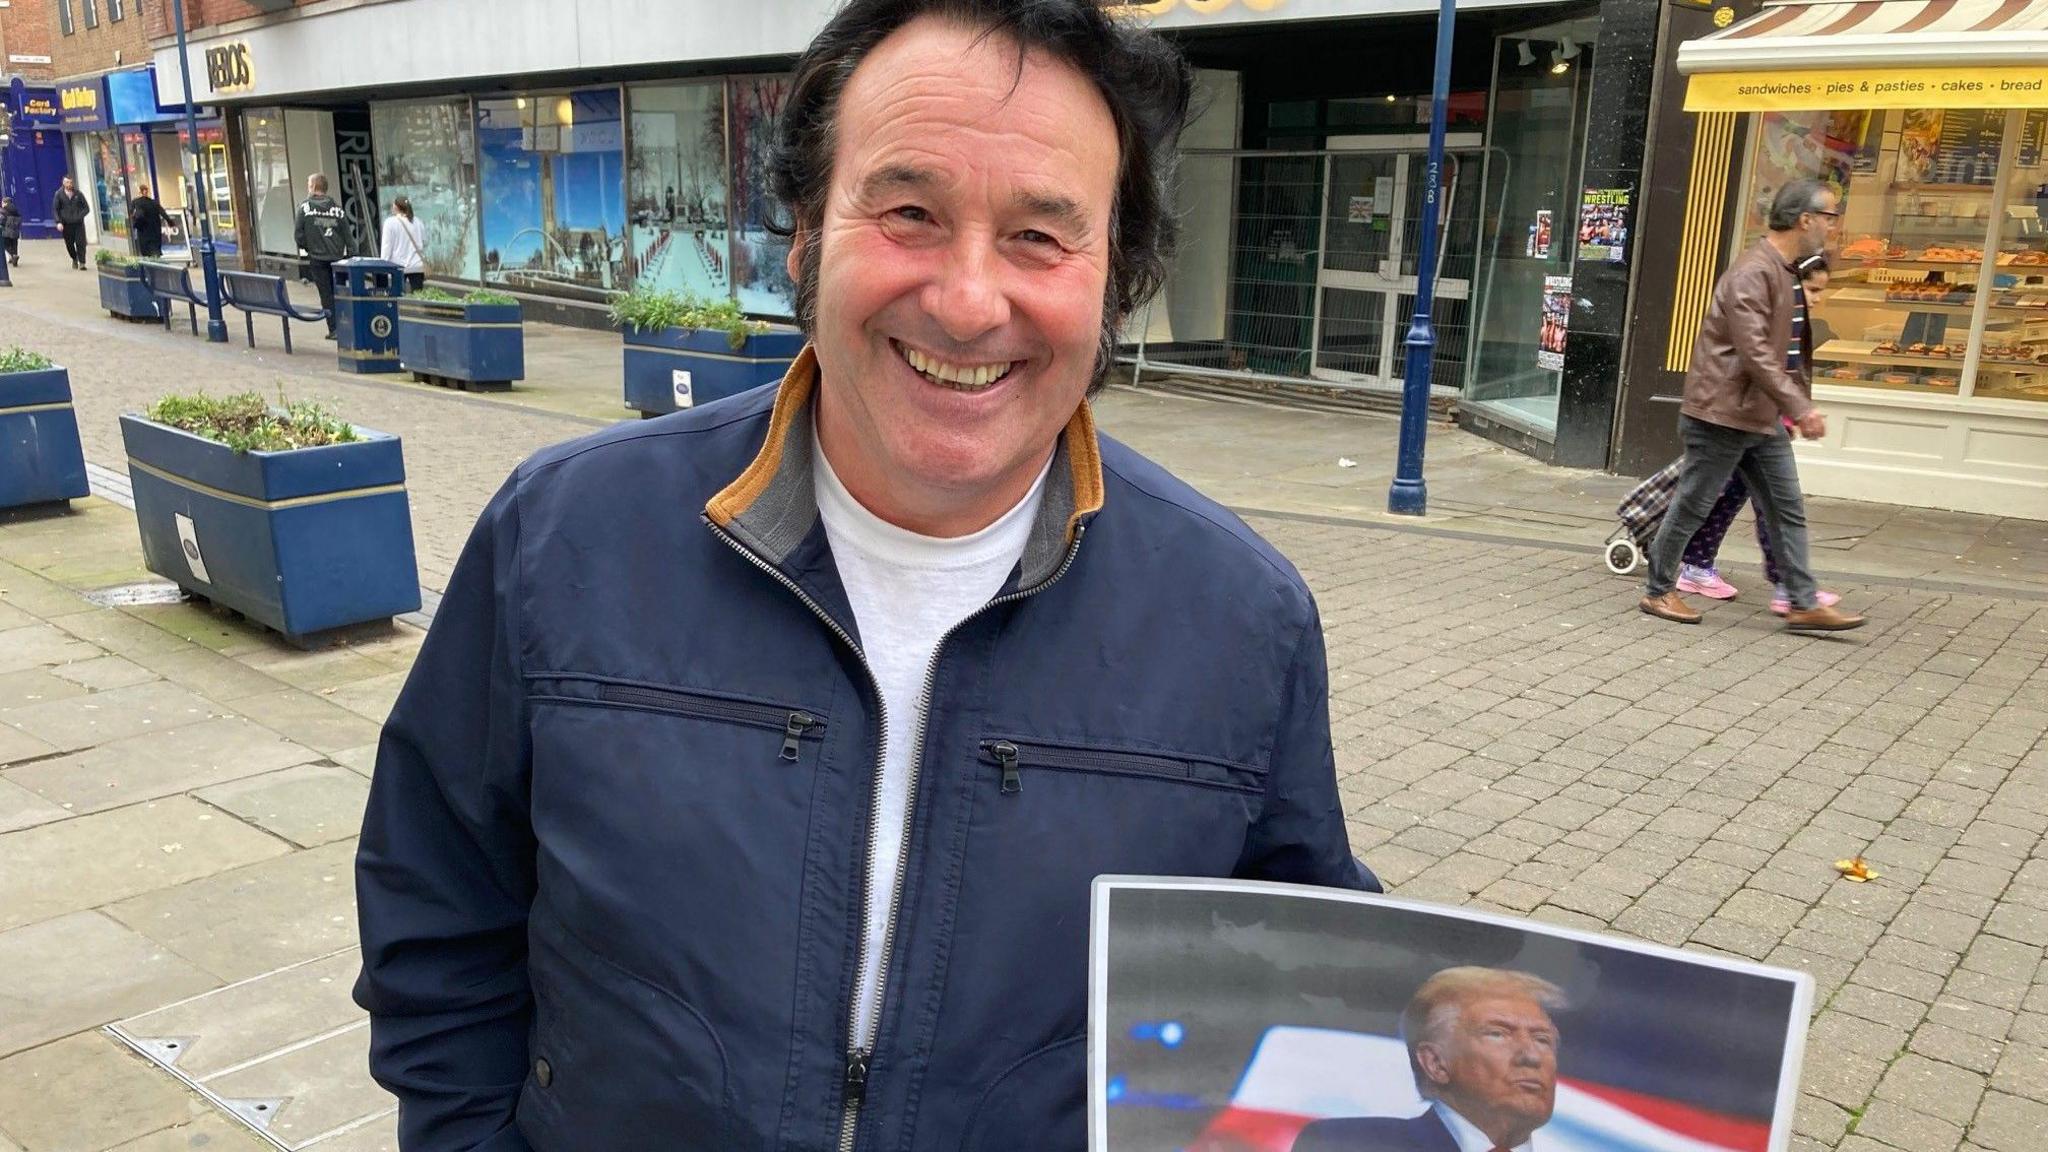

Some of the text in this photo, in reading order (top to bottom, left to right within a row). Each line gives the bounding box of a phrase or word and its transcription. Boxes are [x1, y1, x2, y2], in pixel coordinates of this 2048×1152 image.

[205, 43, 250, 92] REBOS
[1738, 79, 2042, 95] sandwiches pies & pasties cakes bread
[30, 99, 50, 108] Card
[24, 105, 57, 116] Factory
[1584, 194, 1630, 205] WRESTLING
